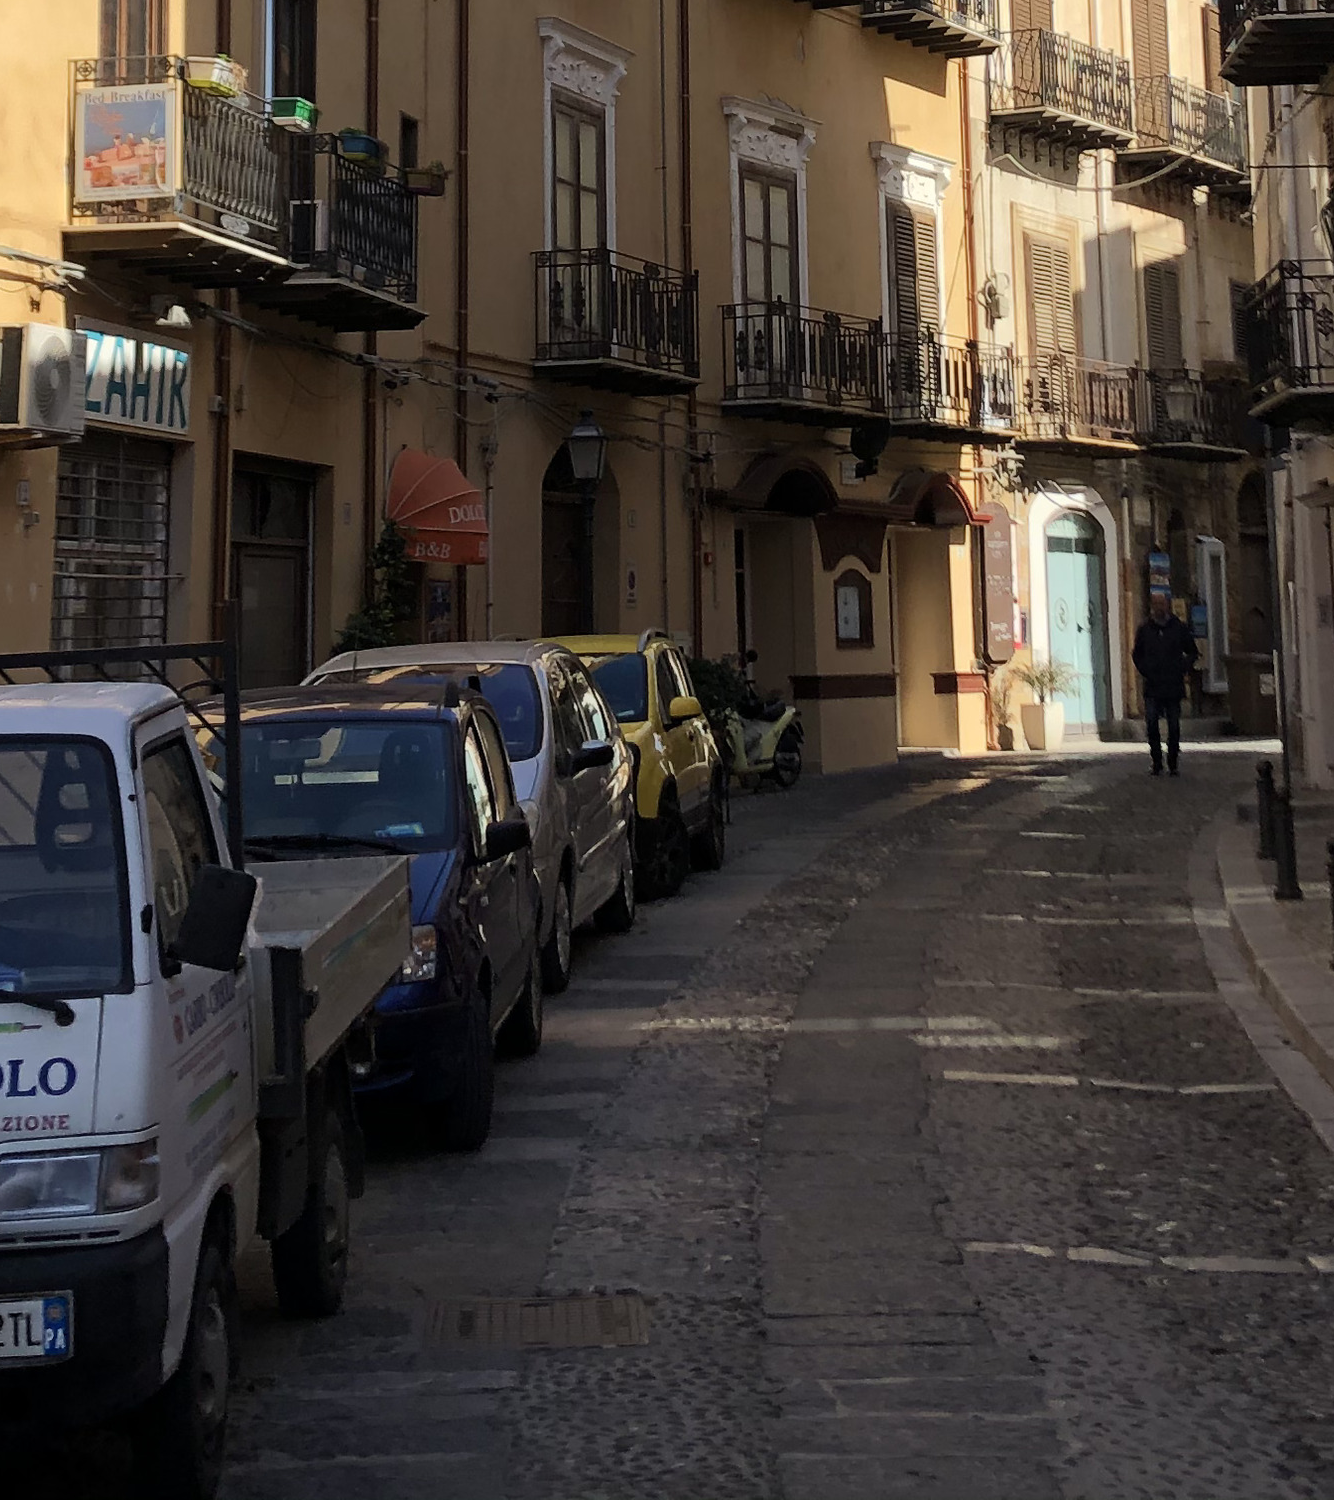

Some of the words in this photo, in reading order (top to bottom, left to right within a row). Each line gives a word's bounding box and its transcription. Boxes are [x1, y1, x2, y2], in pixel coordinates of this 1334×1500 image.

[85, 92, 106, 104] Bed
[111, 89, 166, 102] Breakfast
[85, 329, 188, 429] ZAHIR
[414, 541, 451, 558] B&B
[44, 1327, 66, 1349] PA
